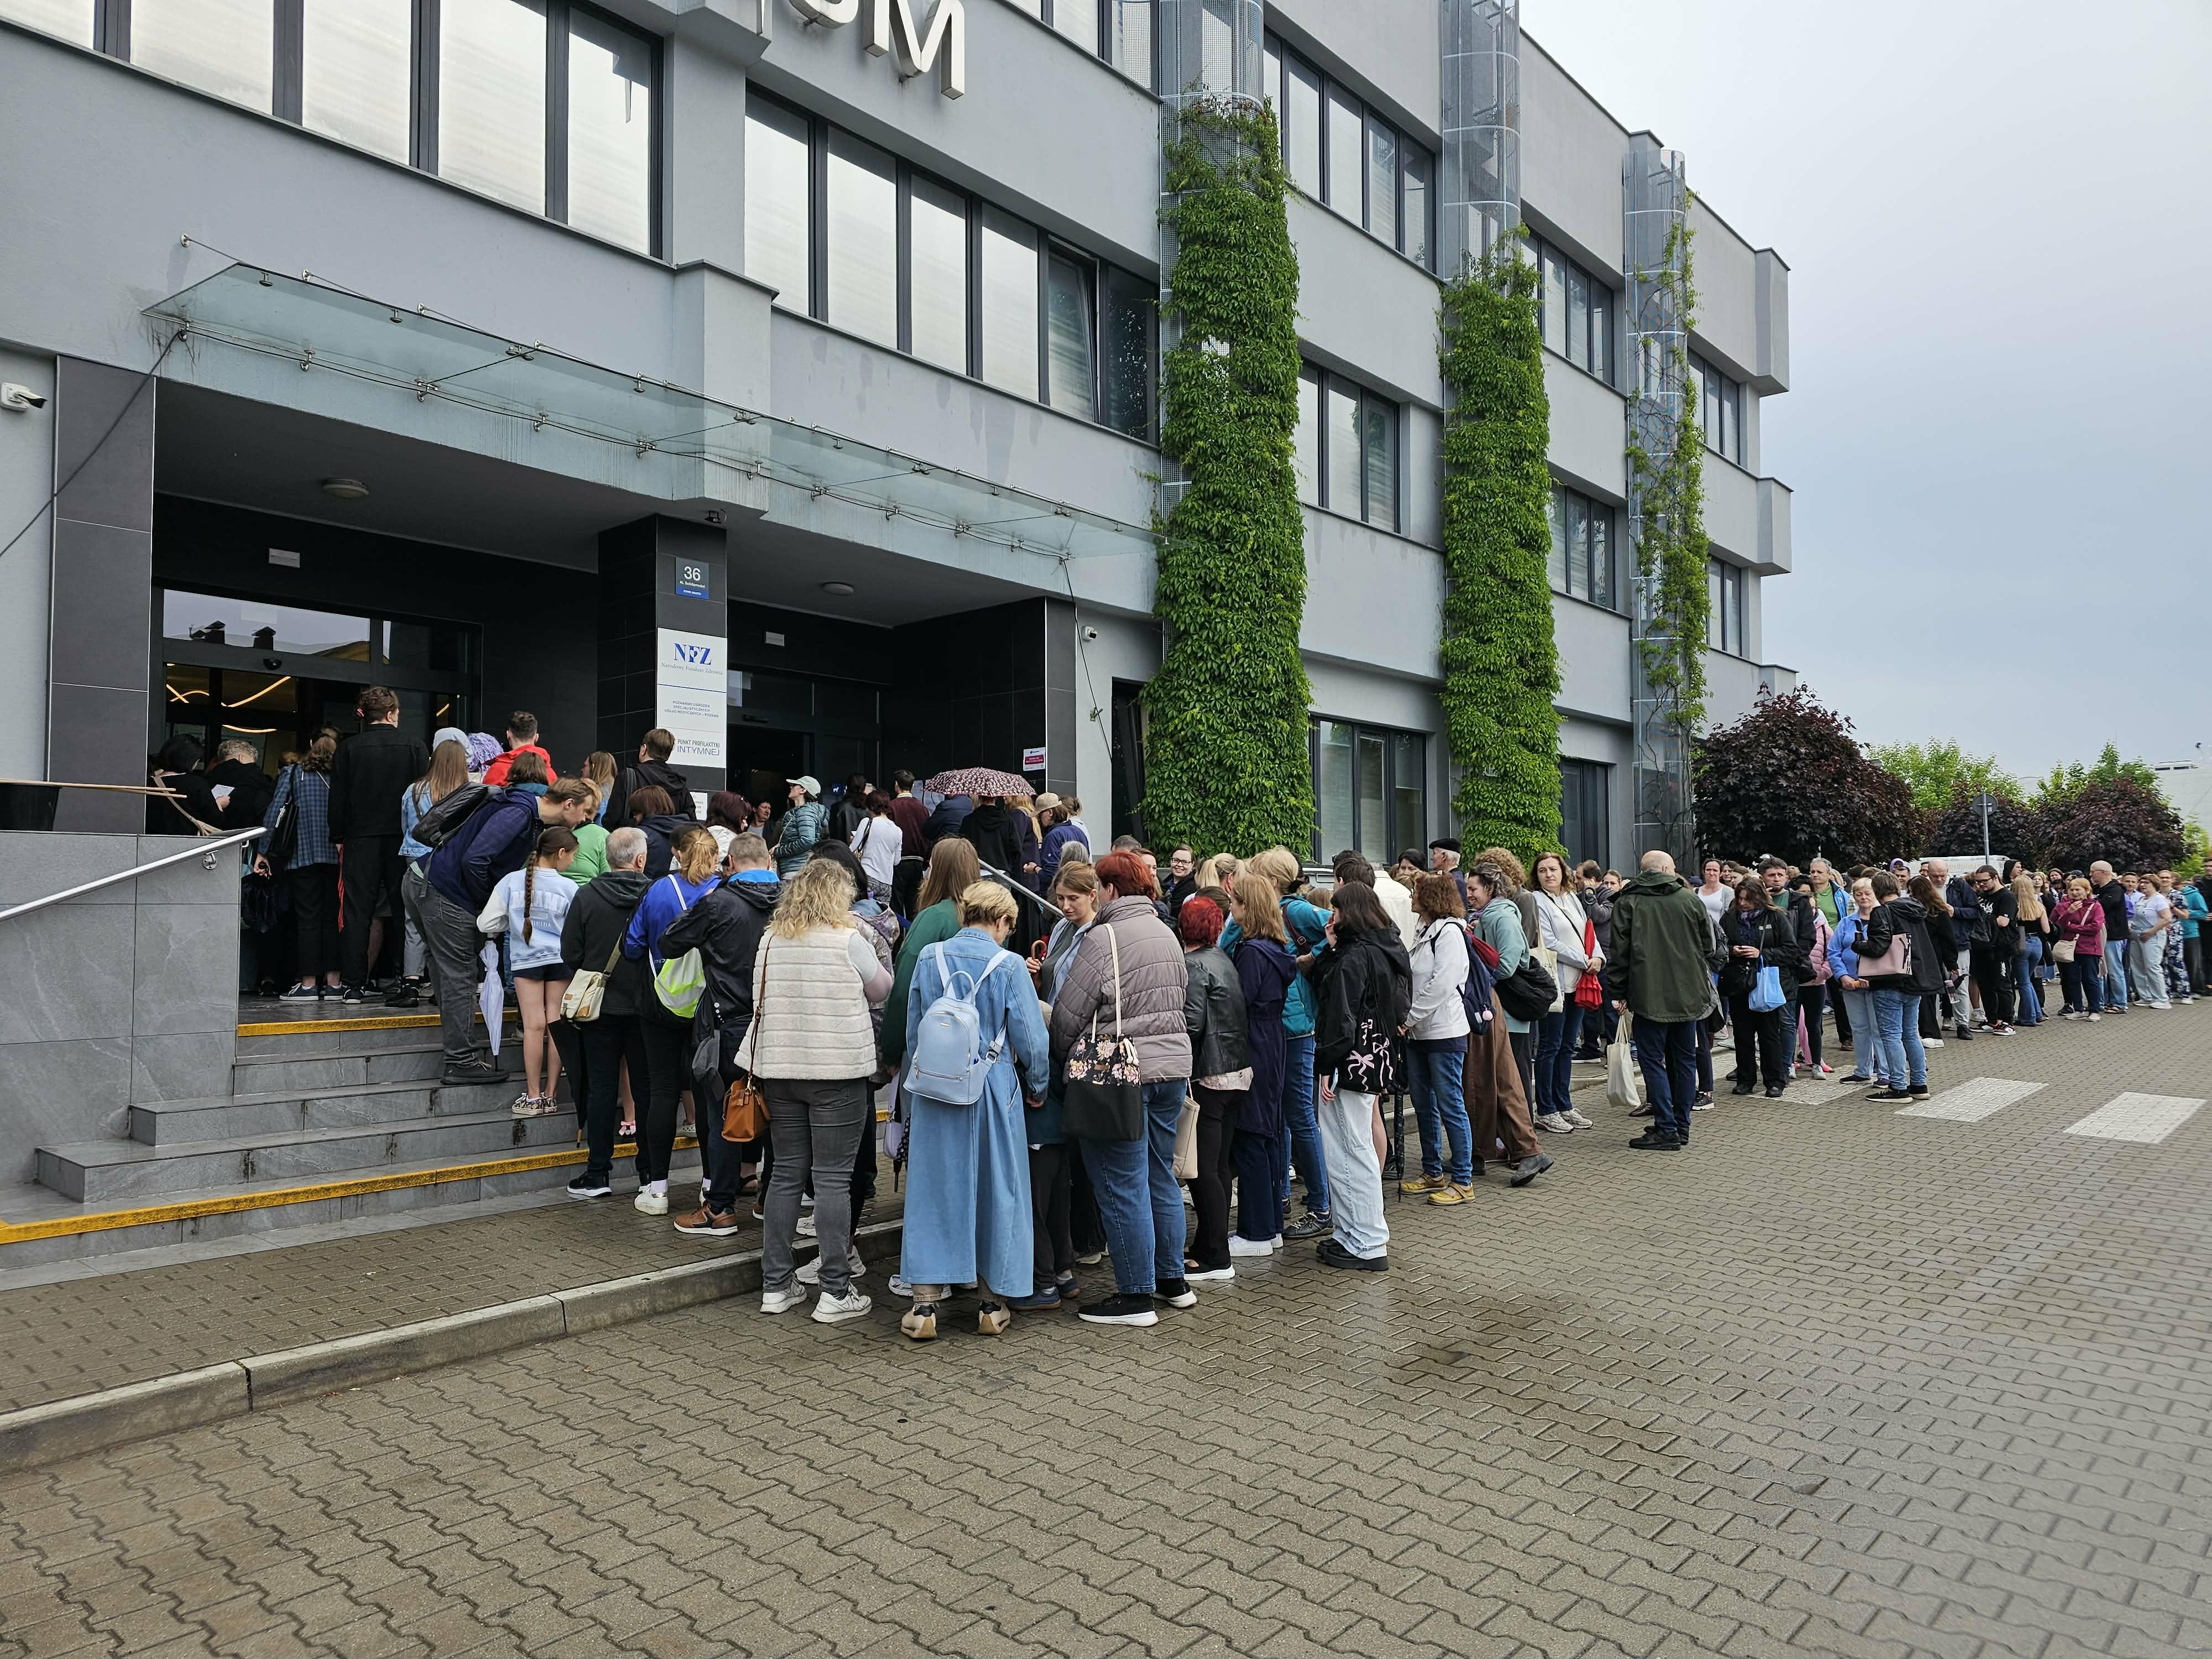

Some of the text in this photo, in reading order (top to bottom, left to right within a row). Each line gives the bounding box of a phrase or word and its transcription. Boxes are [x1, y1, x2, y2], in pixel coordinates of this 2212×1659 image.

[684, 566, 701, 581] 36
[673, 643, 712, 665] NFZ
[677, 745, 719, 756] INTYMNEJ
[692, 740, 720, 748] PROFILAKTYKI
